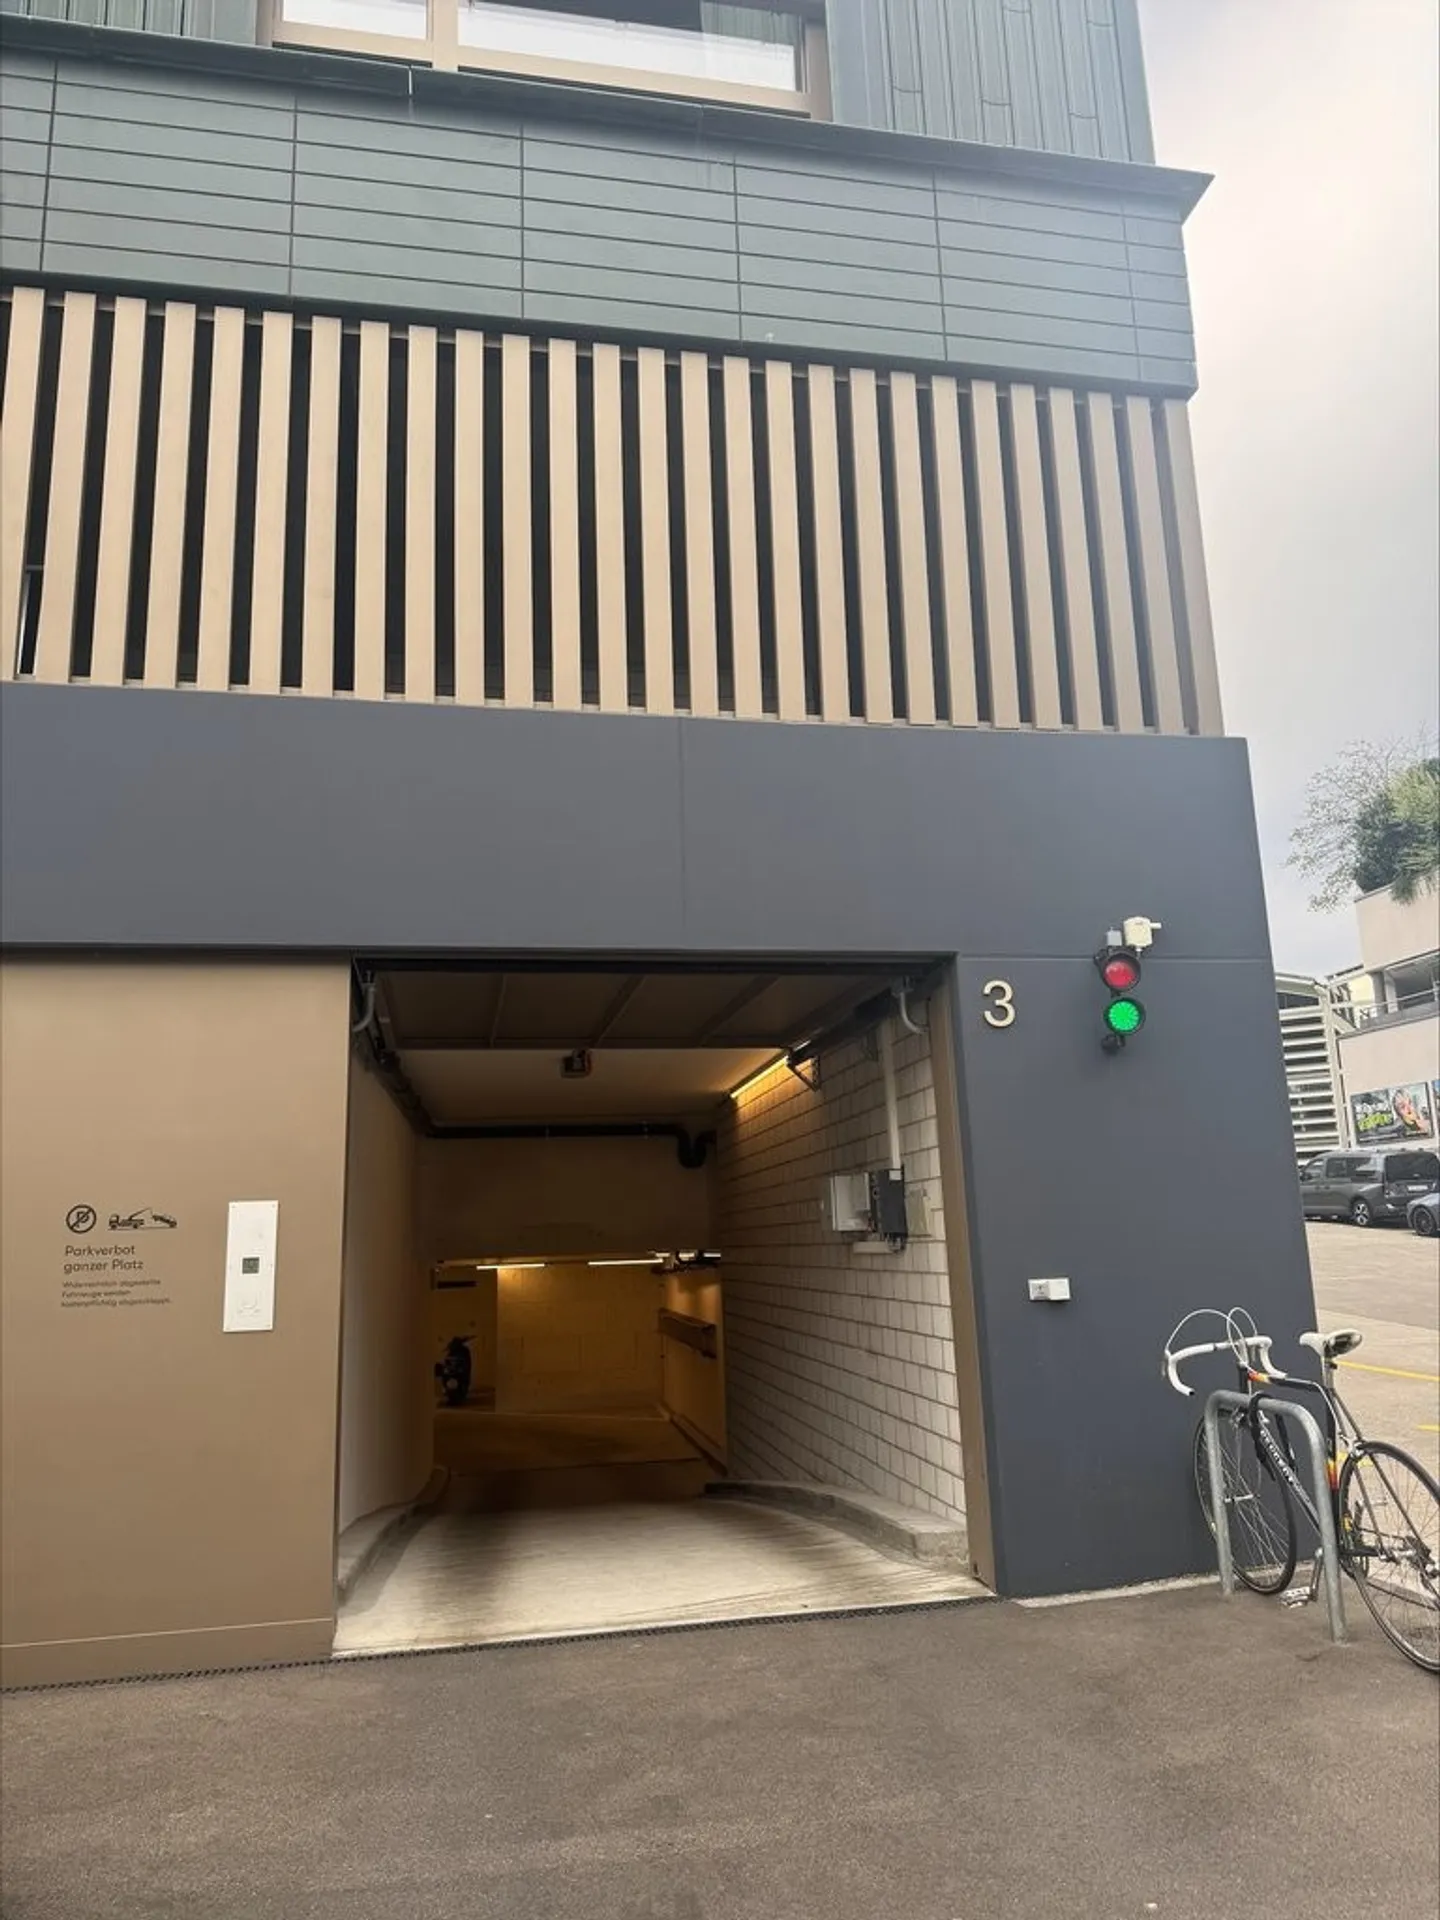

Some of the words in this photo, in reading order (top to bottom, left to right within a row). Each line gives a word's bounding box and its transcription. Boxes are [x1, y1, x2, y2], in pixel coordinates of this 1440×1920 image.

[983, 979, 1016, 1028] 3
[64, 1244, 135, 1257] Parkverbot
[63, 1262, 108, 1274] ganzer
[112, 1258, 144, 1270] Platz
